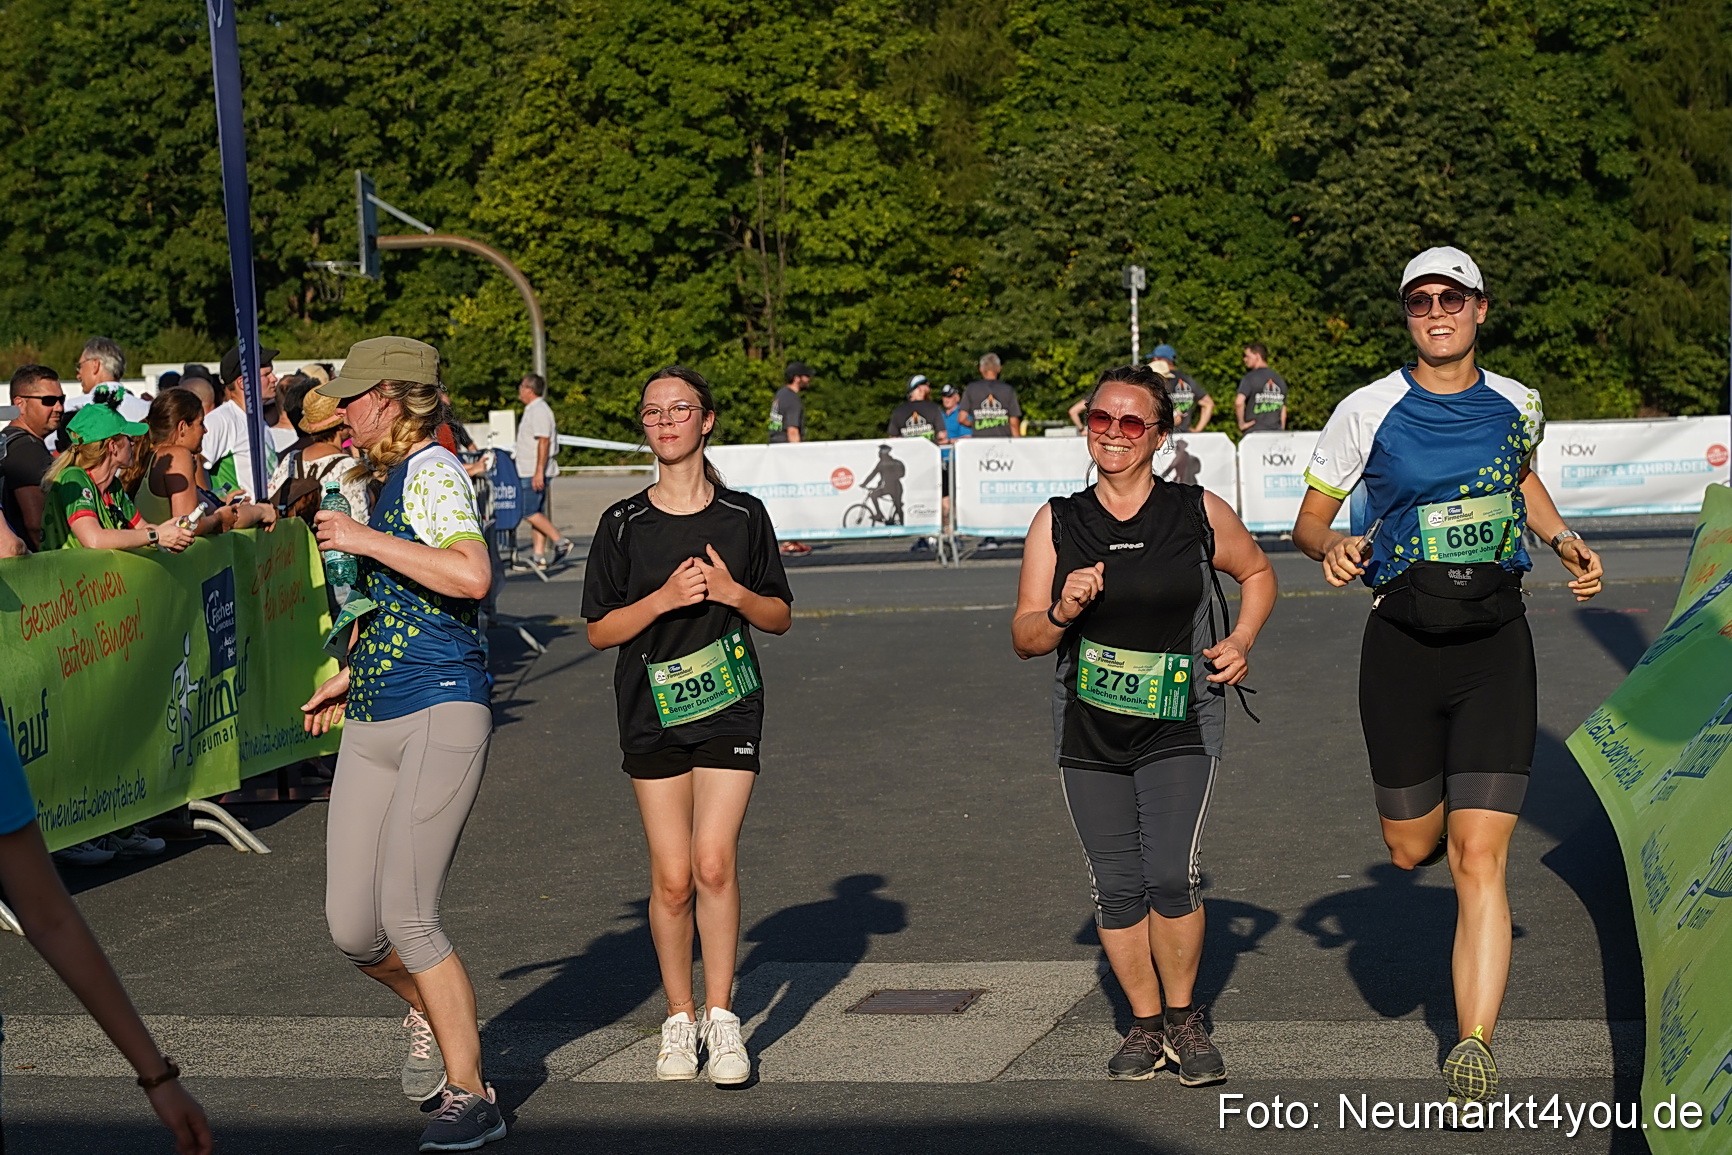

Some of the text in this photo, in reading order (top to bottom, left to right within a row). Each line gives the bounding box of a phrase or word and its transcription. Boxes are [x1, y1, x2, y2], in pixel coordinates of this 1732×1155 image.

[1262, 453, 1297, 467] NOW
[1561, 444, 1597, 457] NOW
[979, 459, 1014, 472] NOW
[1563, 465, 1613, 479] E-BIKES
[1615, 464, 1627, 477] &
[981, 482, 1034, 494] E-BIKES
[1036, 482, 1048, 494] &
[1446, 520, 1494, 550] 686
[1428, 536, 1440, 562] RUN
[20, 571, 127, 642] Gesunde Firmen
[211, 601, 234, 627] Fischer
[56, 598, 144, 680] laufen länger!
[670, 671, 716, 704] 298
[719, 665, 736, 696] 2022
[1080, 667, 1090, 690] RUN
[1094, 667, 1140, 695] 279
[657, 692, 671, 715] RUN
[1086, 684, 1118, 701] Liebchen
[1119, 694, 1149, 706] Monika
[1147, 678, 1159, 709] 2022
[668, 702, 695, 715] Senger
[196, 717, 239, 756] neumark
